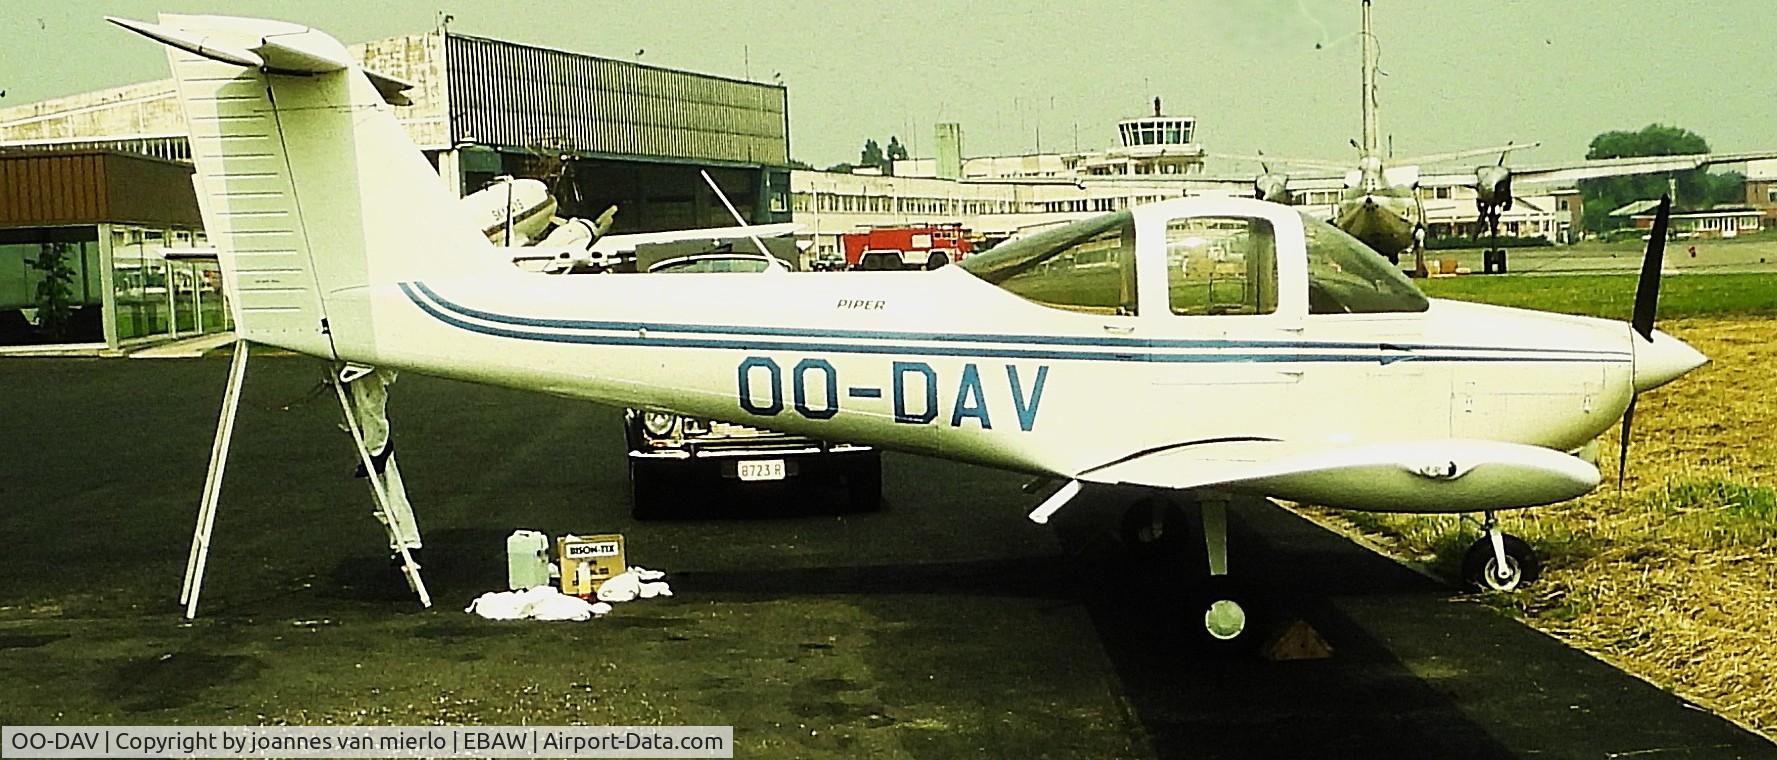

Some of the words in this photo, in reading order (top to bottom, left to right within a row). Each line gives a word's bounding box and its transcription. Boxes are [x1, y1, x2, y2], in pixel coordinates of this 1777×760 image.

[837, 299, 886, 310] PIPER
[738, 356, 1049, 431] OO-DAV
[741, 464, 771, 477] 8723
